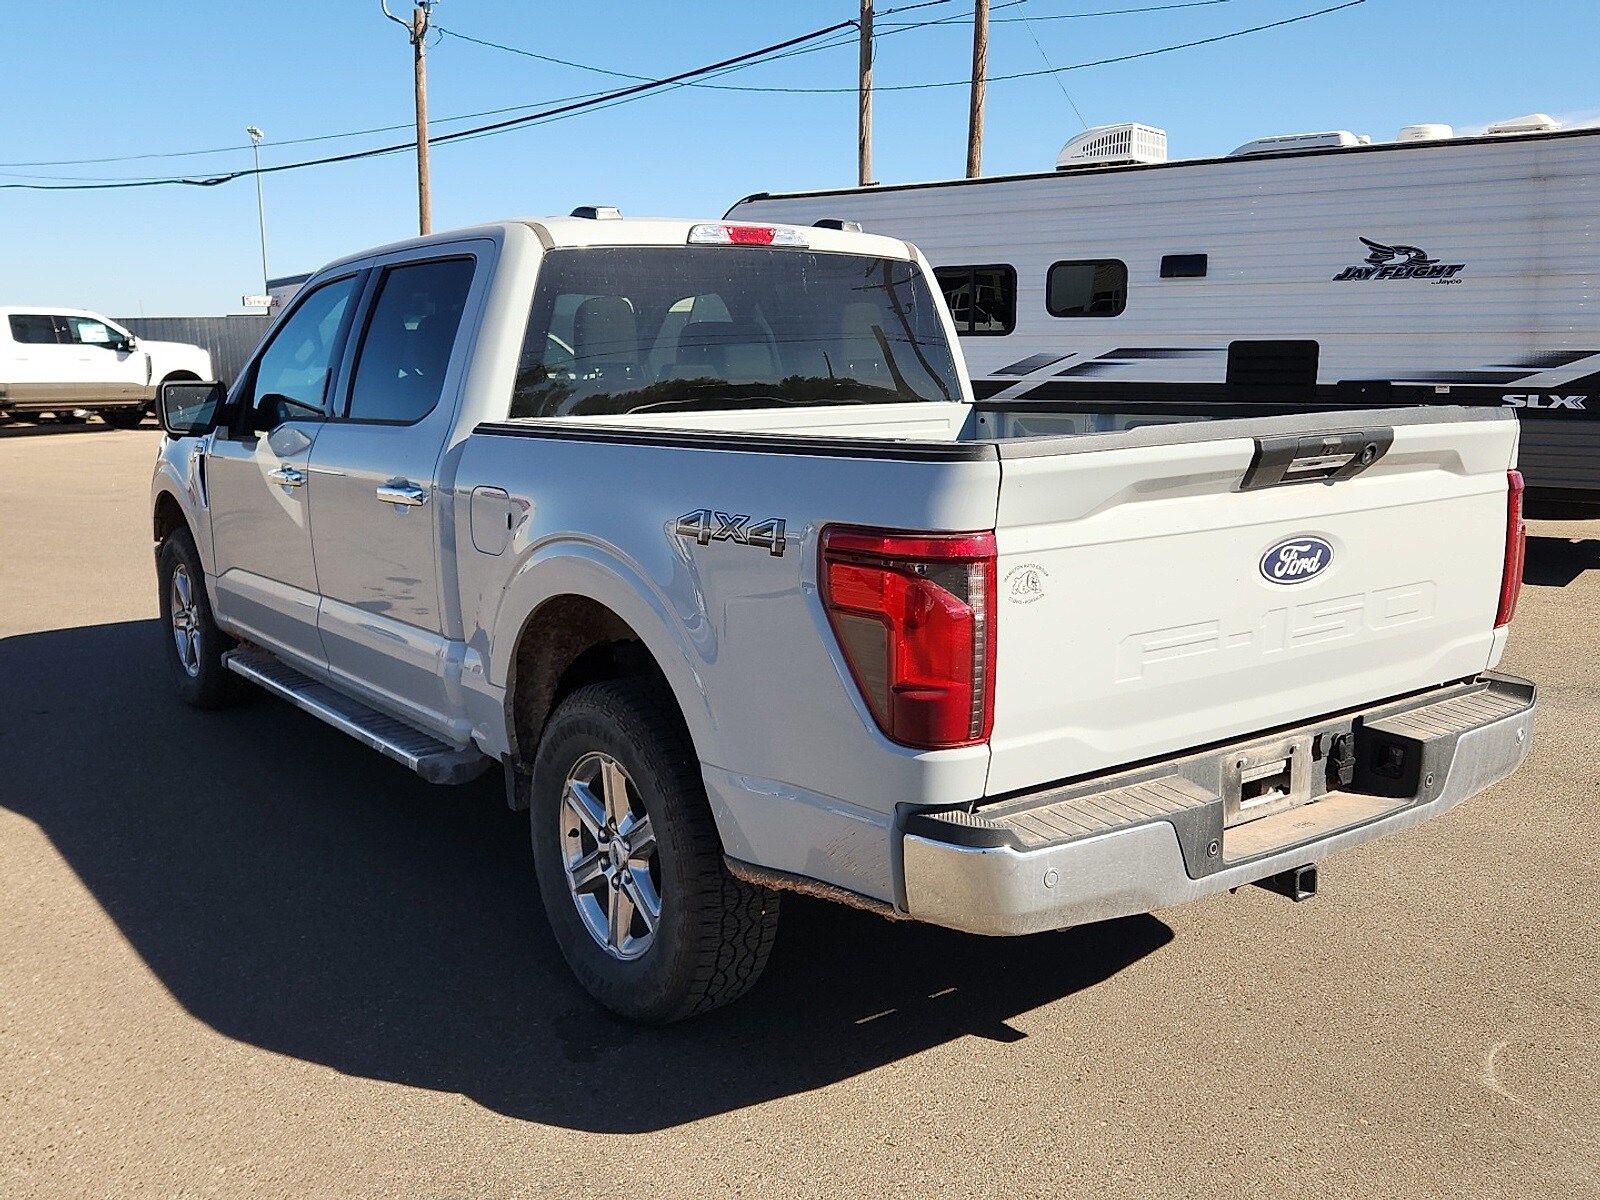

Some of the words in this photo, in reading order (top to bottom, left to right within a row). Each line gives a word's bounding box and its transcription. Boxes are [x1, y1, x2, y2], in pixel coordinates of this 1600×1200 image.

[1501, 394, 1588, 410] SLX
[1274, 544, 1323, 577] Ford
[1114, 579, 1438, 684] F-150
